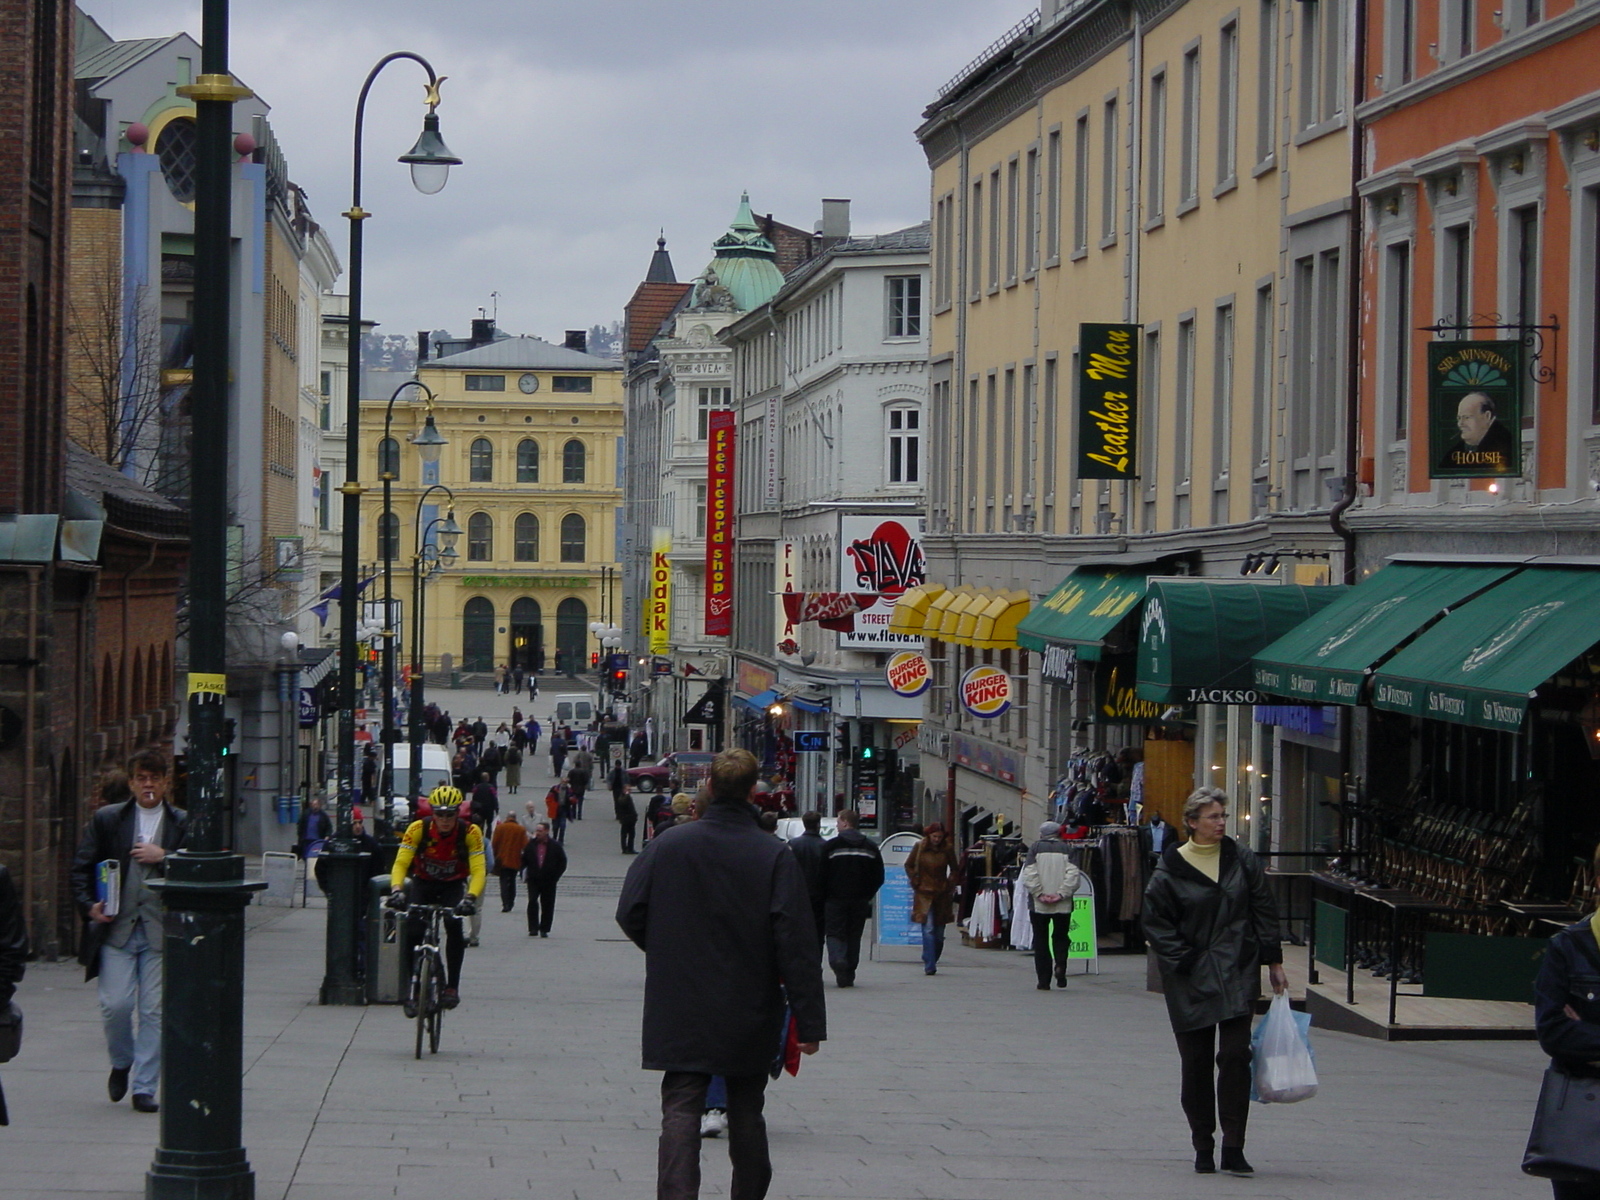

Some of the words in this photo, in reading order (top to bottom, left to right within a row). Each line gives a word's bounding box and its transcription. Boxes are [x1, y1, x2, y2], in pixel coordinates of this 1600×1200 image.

[1086, 330, 1131, 380] Man
[1437, 355, 1460, 375] SIR
[769, 399, 777, 443] MERKANTIL
[1086, 391, 1130, 473] Leather
[715, 429, 727, 473] free
[1451, 450, 1503, 465] HOUSE
[713, 478, 726, 543] record
[653, 552, 670, 632] Kodak
[712, 548, 724, 595] shop
[784, 543, 794, 636] FLAA
[862, 613, 893, 625] STREET
[888, 656, 924, 680] BURGER
[892, 663, 928, 691] KING
[965, 674, 1007, 694] BURGER
[966, 683, 1009, 707] KING
